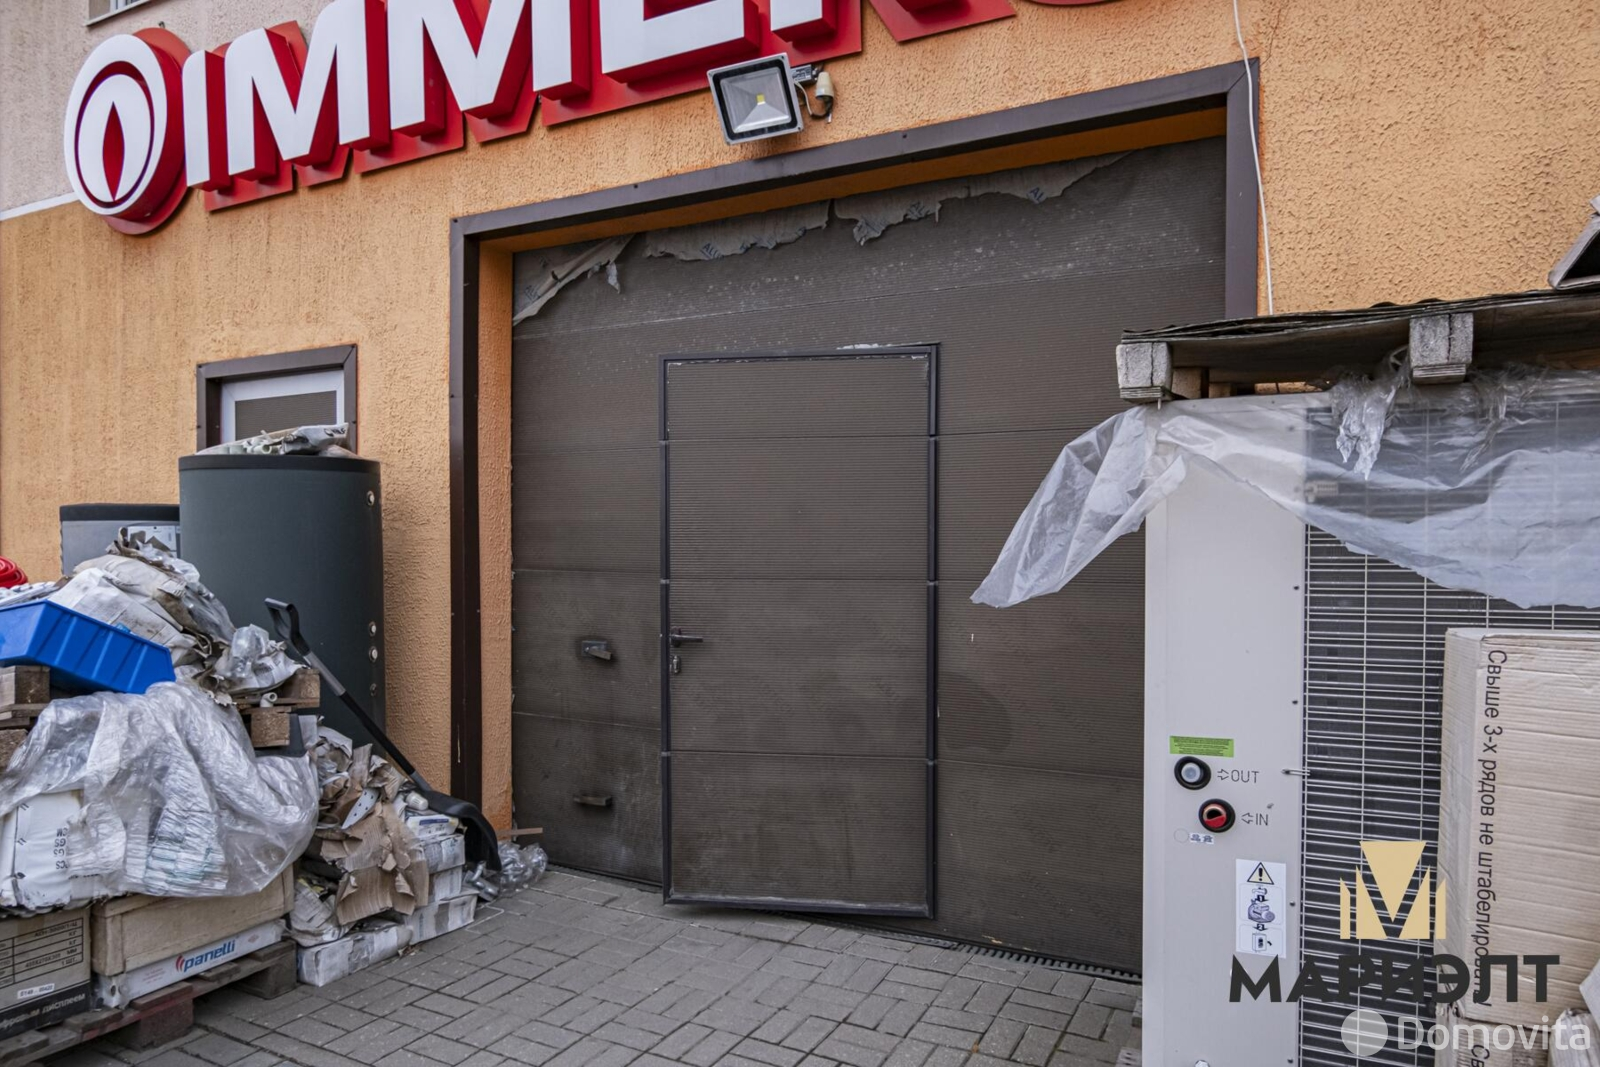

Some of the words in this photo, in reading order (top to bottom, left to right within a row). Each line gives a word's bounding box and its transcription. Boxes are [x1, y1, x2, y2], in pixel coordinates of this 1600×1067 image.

[1484, 649, 1507, 718] Свыше
[1483, 724, 1503, 754] 3-х
[1230, 769, 1260, 784] OUT
[1477, 759, 1497, 816] рядов
[1255, 812, 1269, 826] IN
[1479, 822, 1494, 845] не
[183, 939, 236, 973] panelli
